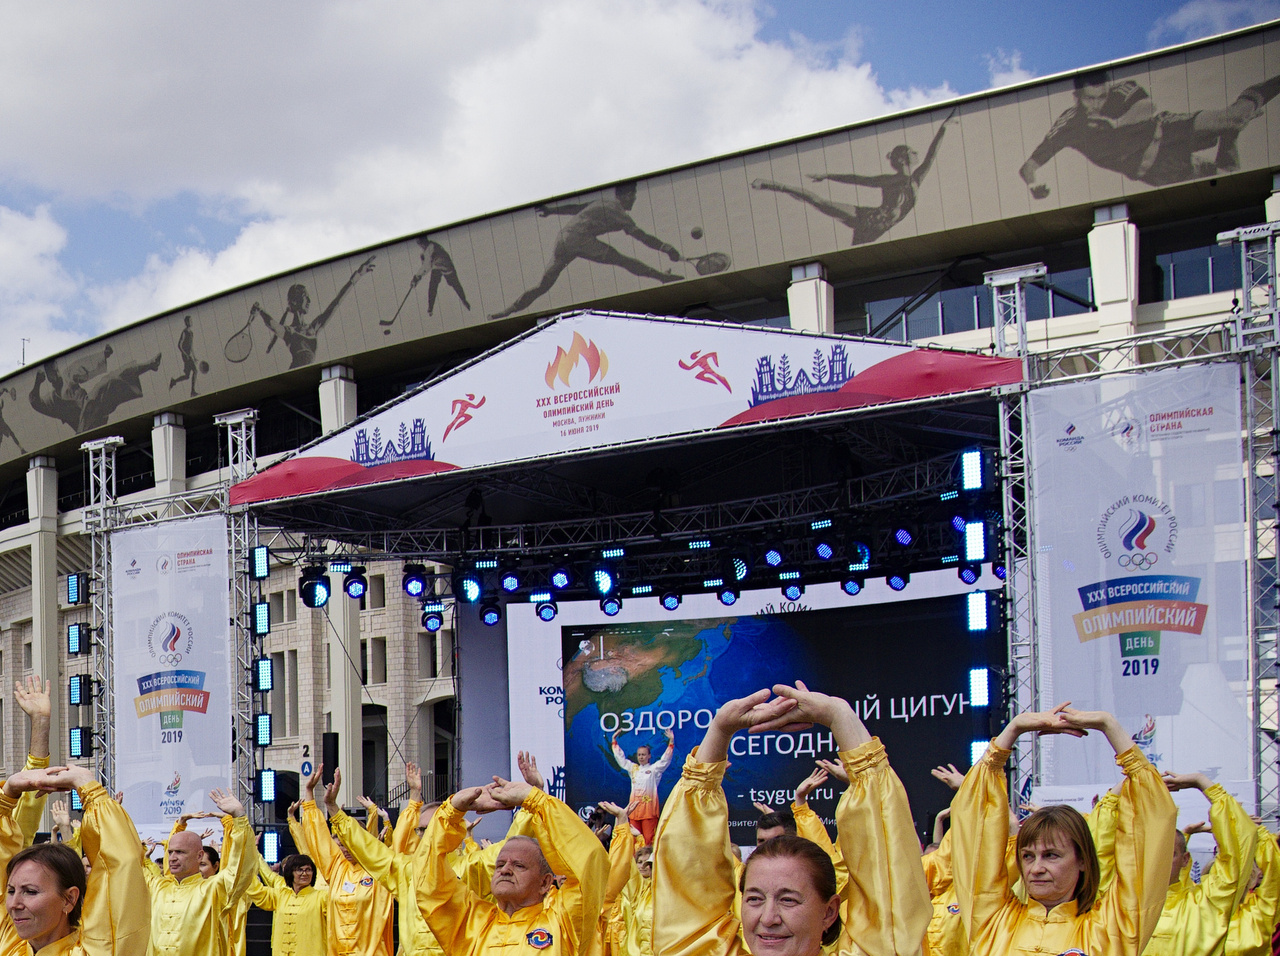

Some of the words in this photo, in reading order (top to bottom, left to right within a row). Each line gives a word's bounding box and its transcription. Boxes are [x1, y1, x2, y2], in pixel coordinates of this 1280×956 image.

[554, 382, 621, 404] ВСЕРОССИЙСКИЙ
[543, 401, 594, 418] ОЛИМПИЙСКИЙ
[596, 399, 614, 410] ДЕНЬ
[1149, 406, 1214, 423] ОЛИМПИЙСКАЯ
[578, 412, 606, 423] ЛУЖНИКИ
[568, 427, 584, 436] ИЮНЯ
[586, 424, 599, 433] 2019
[1150, 421, 1183, 433] СТРАНА
[1096, 495, 1130, 560] ОЛИМПИЙСКИЙ
[1132, 494, 1171, 516] КОМИТЕТ
[1164, 516, 1178, 553] РОССИИ
[177, 558, 196, 567] СТРАНА
[1107, 580, 1190, 598] ВСЕРОССИЙСКИЙ
[1082, 604, 1197, 634] ОЛИМПИЙСКИЙ
[1125, 636, 1155, 651] ДЕНЬ
[1122, 658, 1160, 677] 2019
[154, 674, 200, 687] ВСЕРОССИЙСКИЙ
[140, 691, 204, 713] ОЛИМПИЙСКИЙ
[163, 714, 180, 725] ДЕНЬ
[600, 708, 722, 736] ОЗДОРО
[161, 730, 183, 744] 2019
[730, 731, 840, 759] СЕГОДН
[302, 744, 310, 757] 2
[303, 763, 310, 773] A
[749, 788, 834, 805] tsygu.ru
[163, 806, 182, 815] 2019
